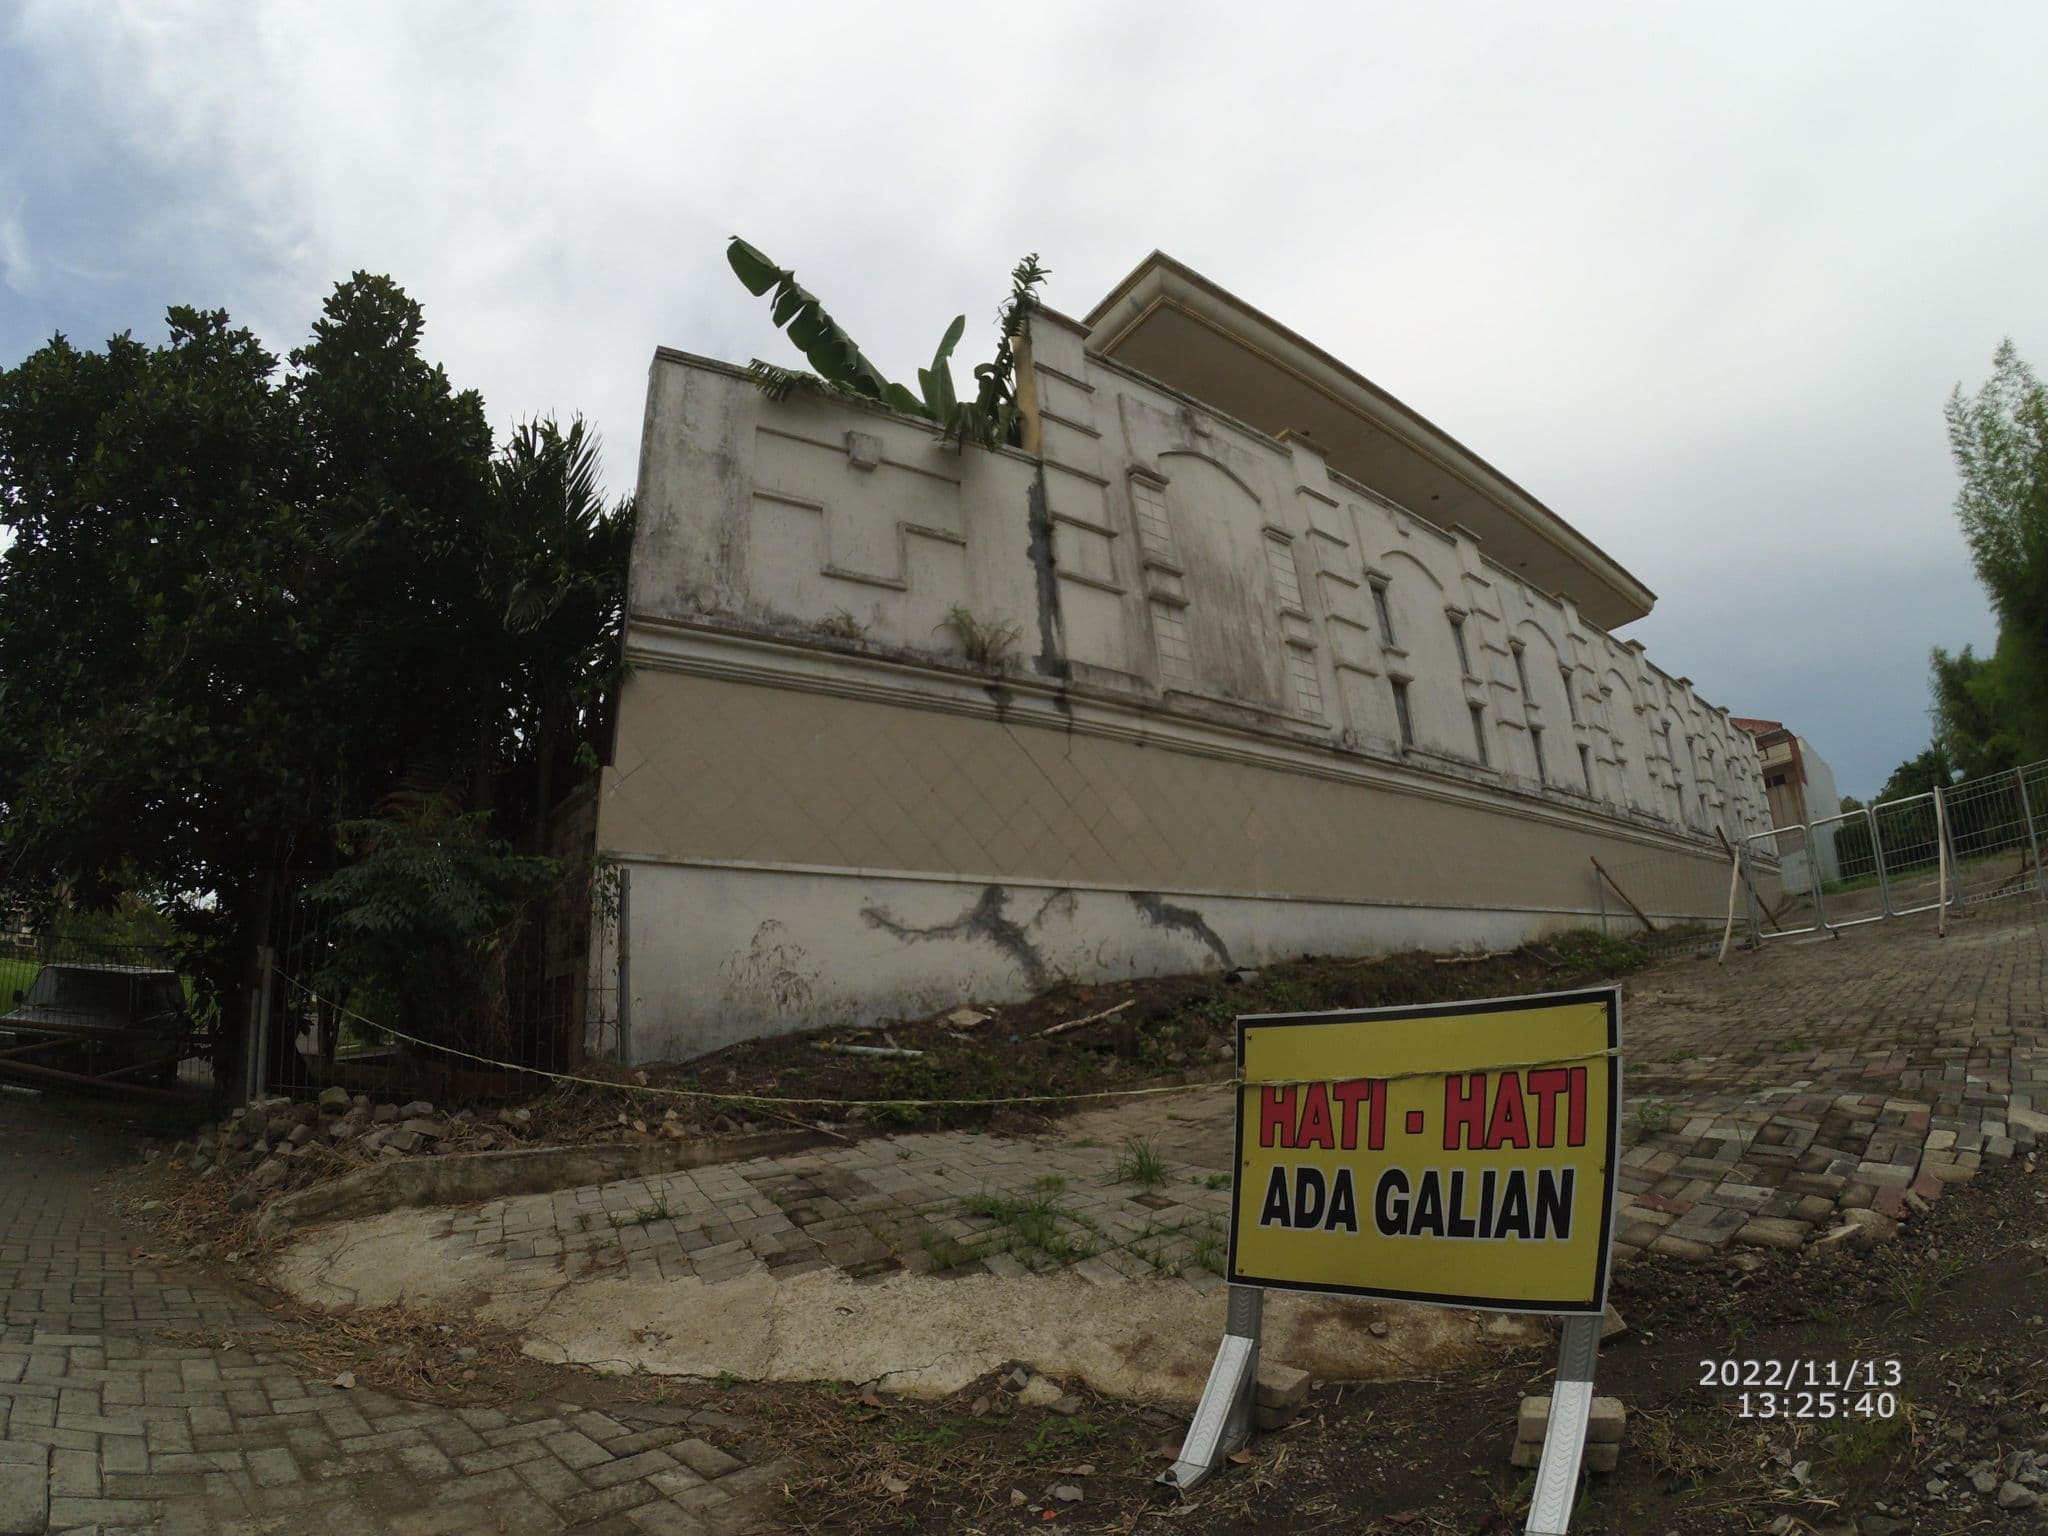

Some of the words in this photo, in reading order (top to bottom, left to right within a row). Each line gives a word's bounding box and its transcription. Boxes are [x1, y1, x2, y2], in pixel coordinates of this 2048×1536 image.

[1259, 1079, 1388, 1150] HATI
[1443, 1066, 1588, 1151] HATI
[1259, 1165, 1358, 1233] ADA
[1374, 1167, 1576, 1240] GALIAN
